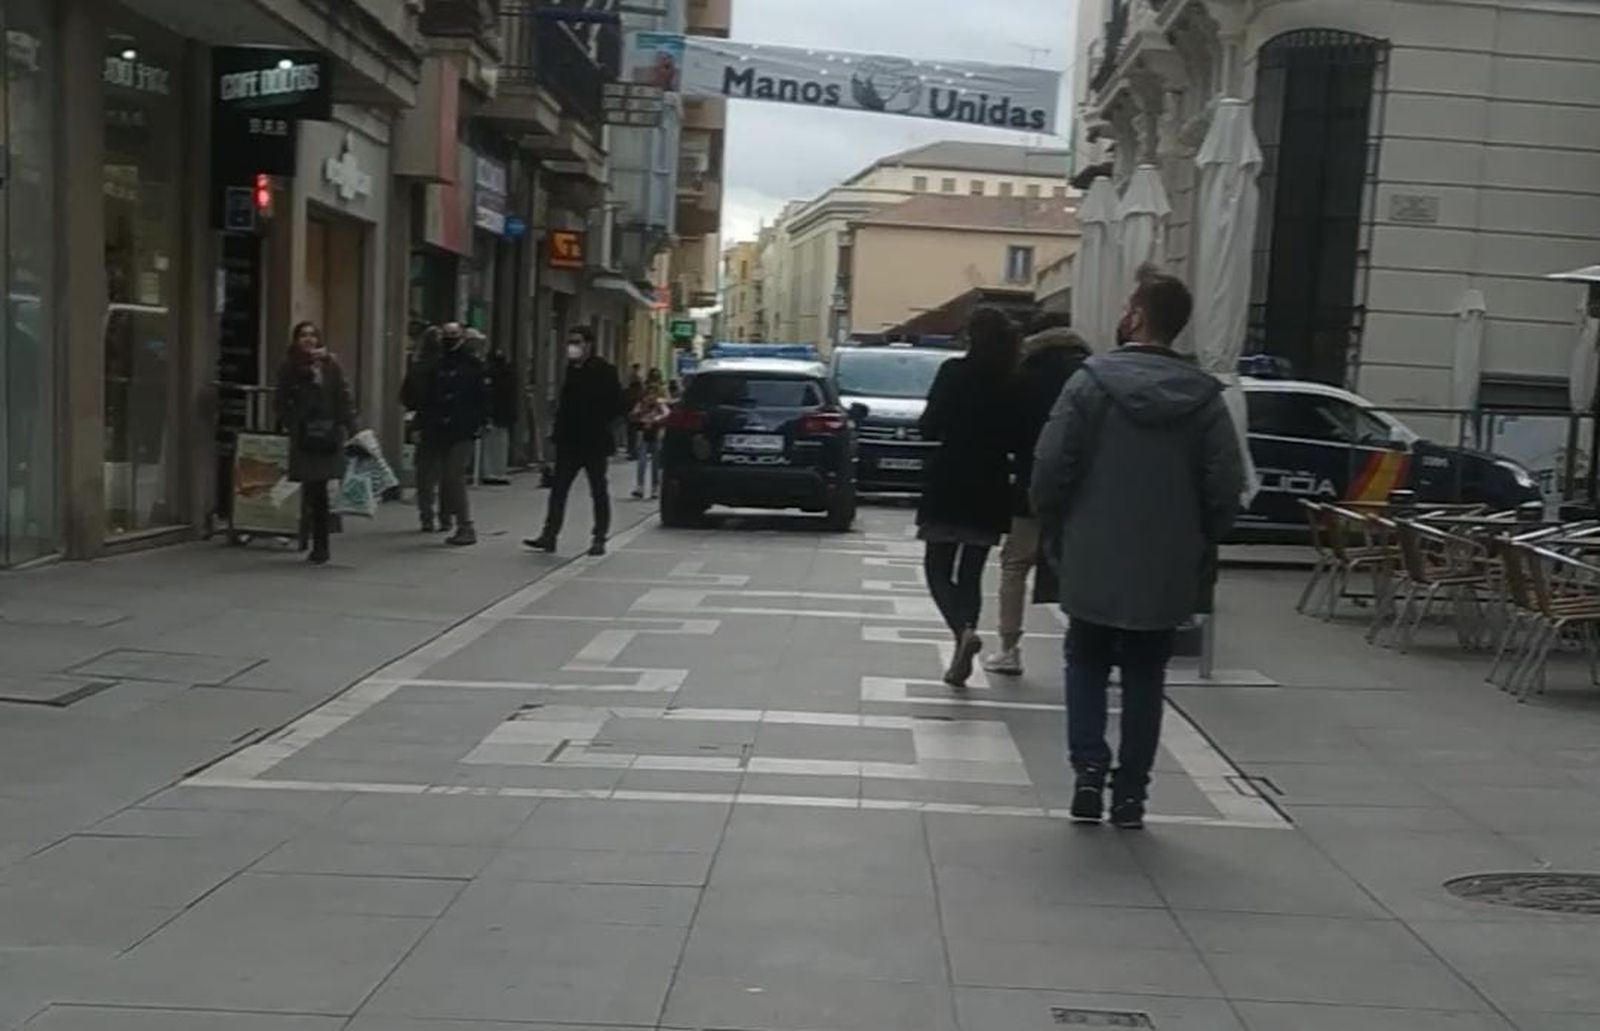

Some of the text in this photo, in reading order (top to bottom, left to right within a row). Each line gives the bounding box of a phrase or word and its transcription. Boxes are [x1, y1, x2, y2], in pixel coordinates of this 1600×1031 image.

[722, 65, 1047, 131] Manos Unidas
[249, 118, 288, 136] BAR
